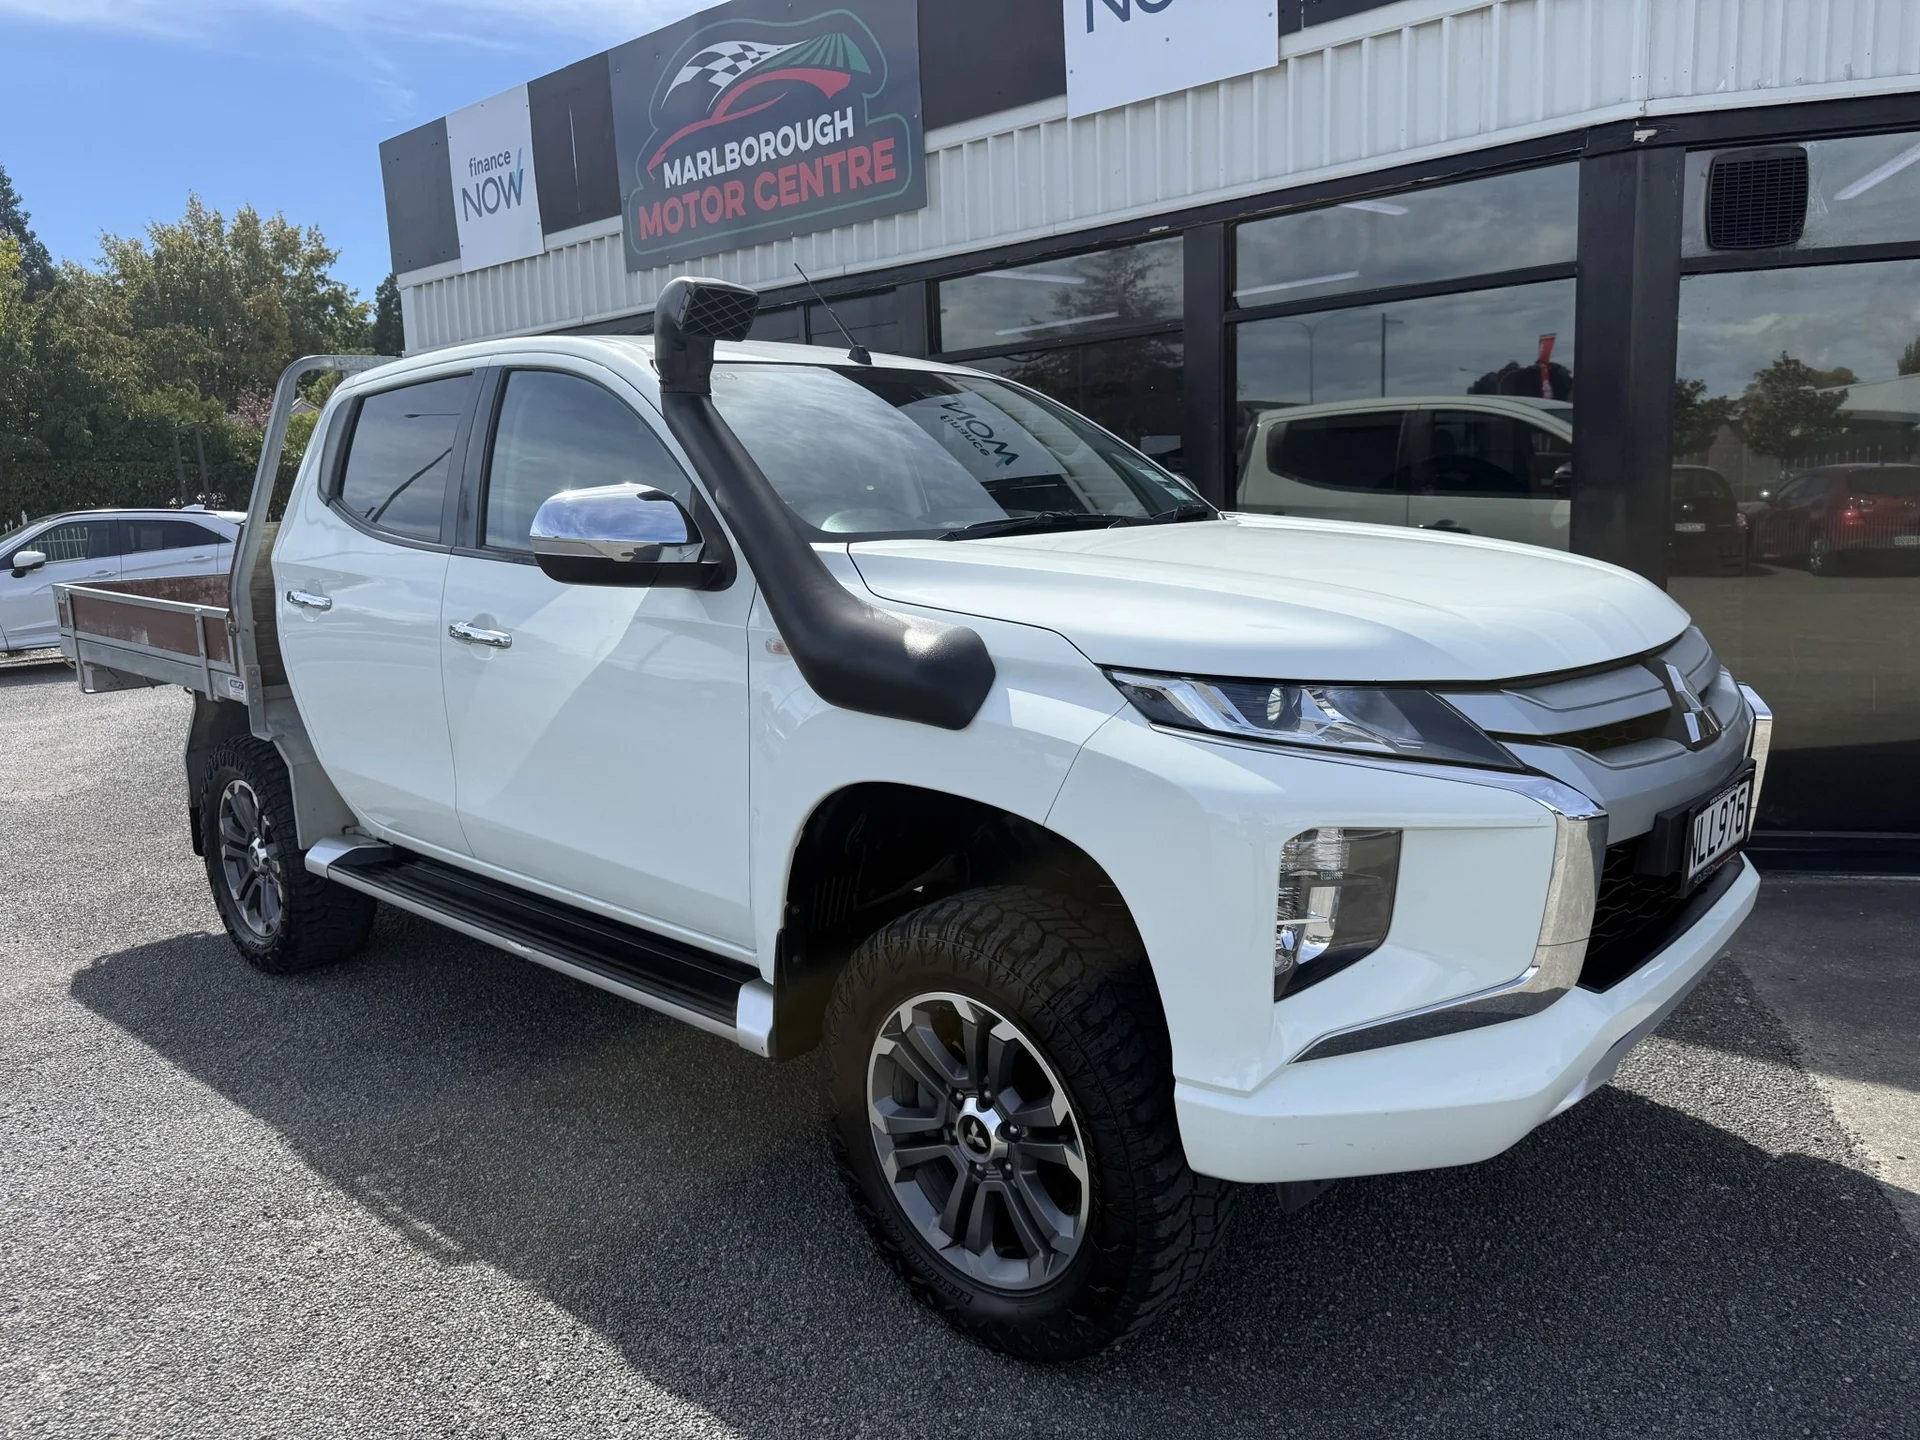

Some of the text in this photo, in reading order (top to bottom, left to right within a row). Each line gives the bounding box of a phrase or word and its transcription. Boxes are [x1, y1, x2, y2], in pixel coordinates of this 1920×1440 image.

[469, 150, 511, 177] finance
[663, 107, 854, 189] MARLBOROUGH
[461, 168, 523, 222] NOW
[638, 138, 897, 241] MOTOR CENTRE
[1692, 787, 1746, 868] NLL976
